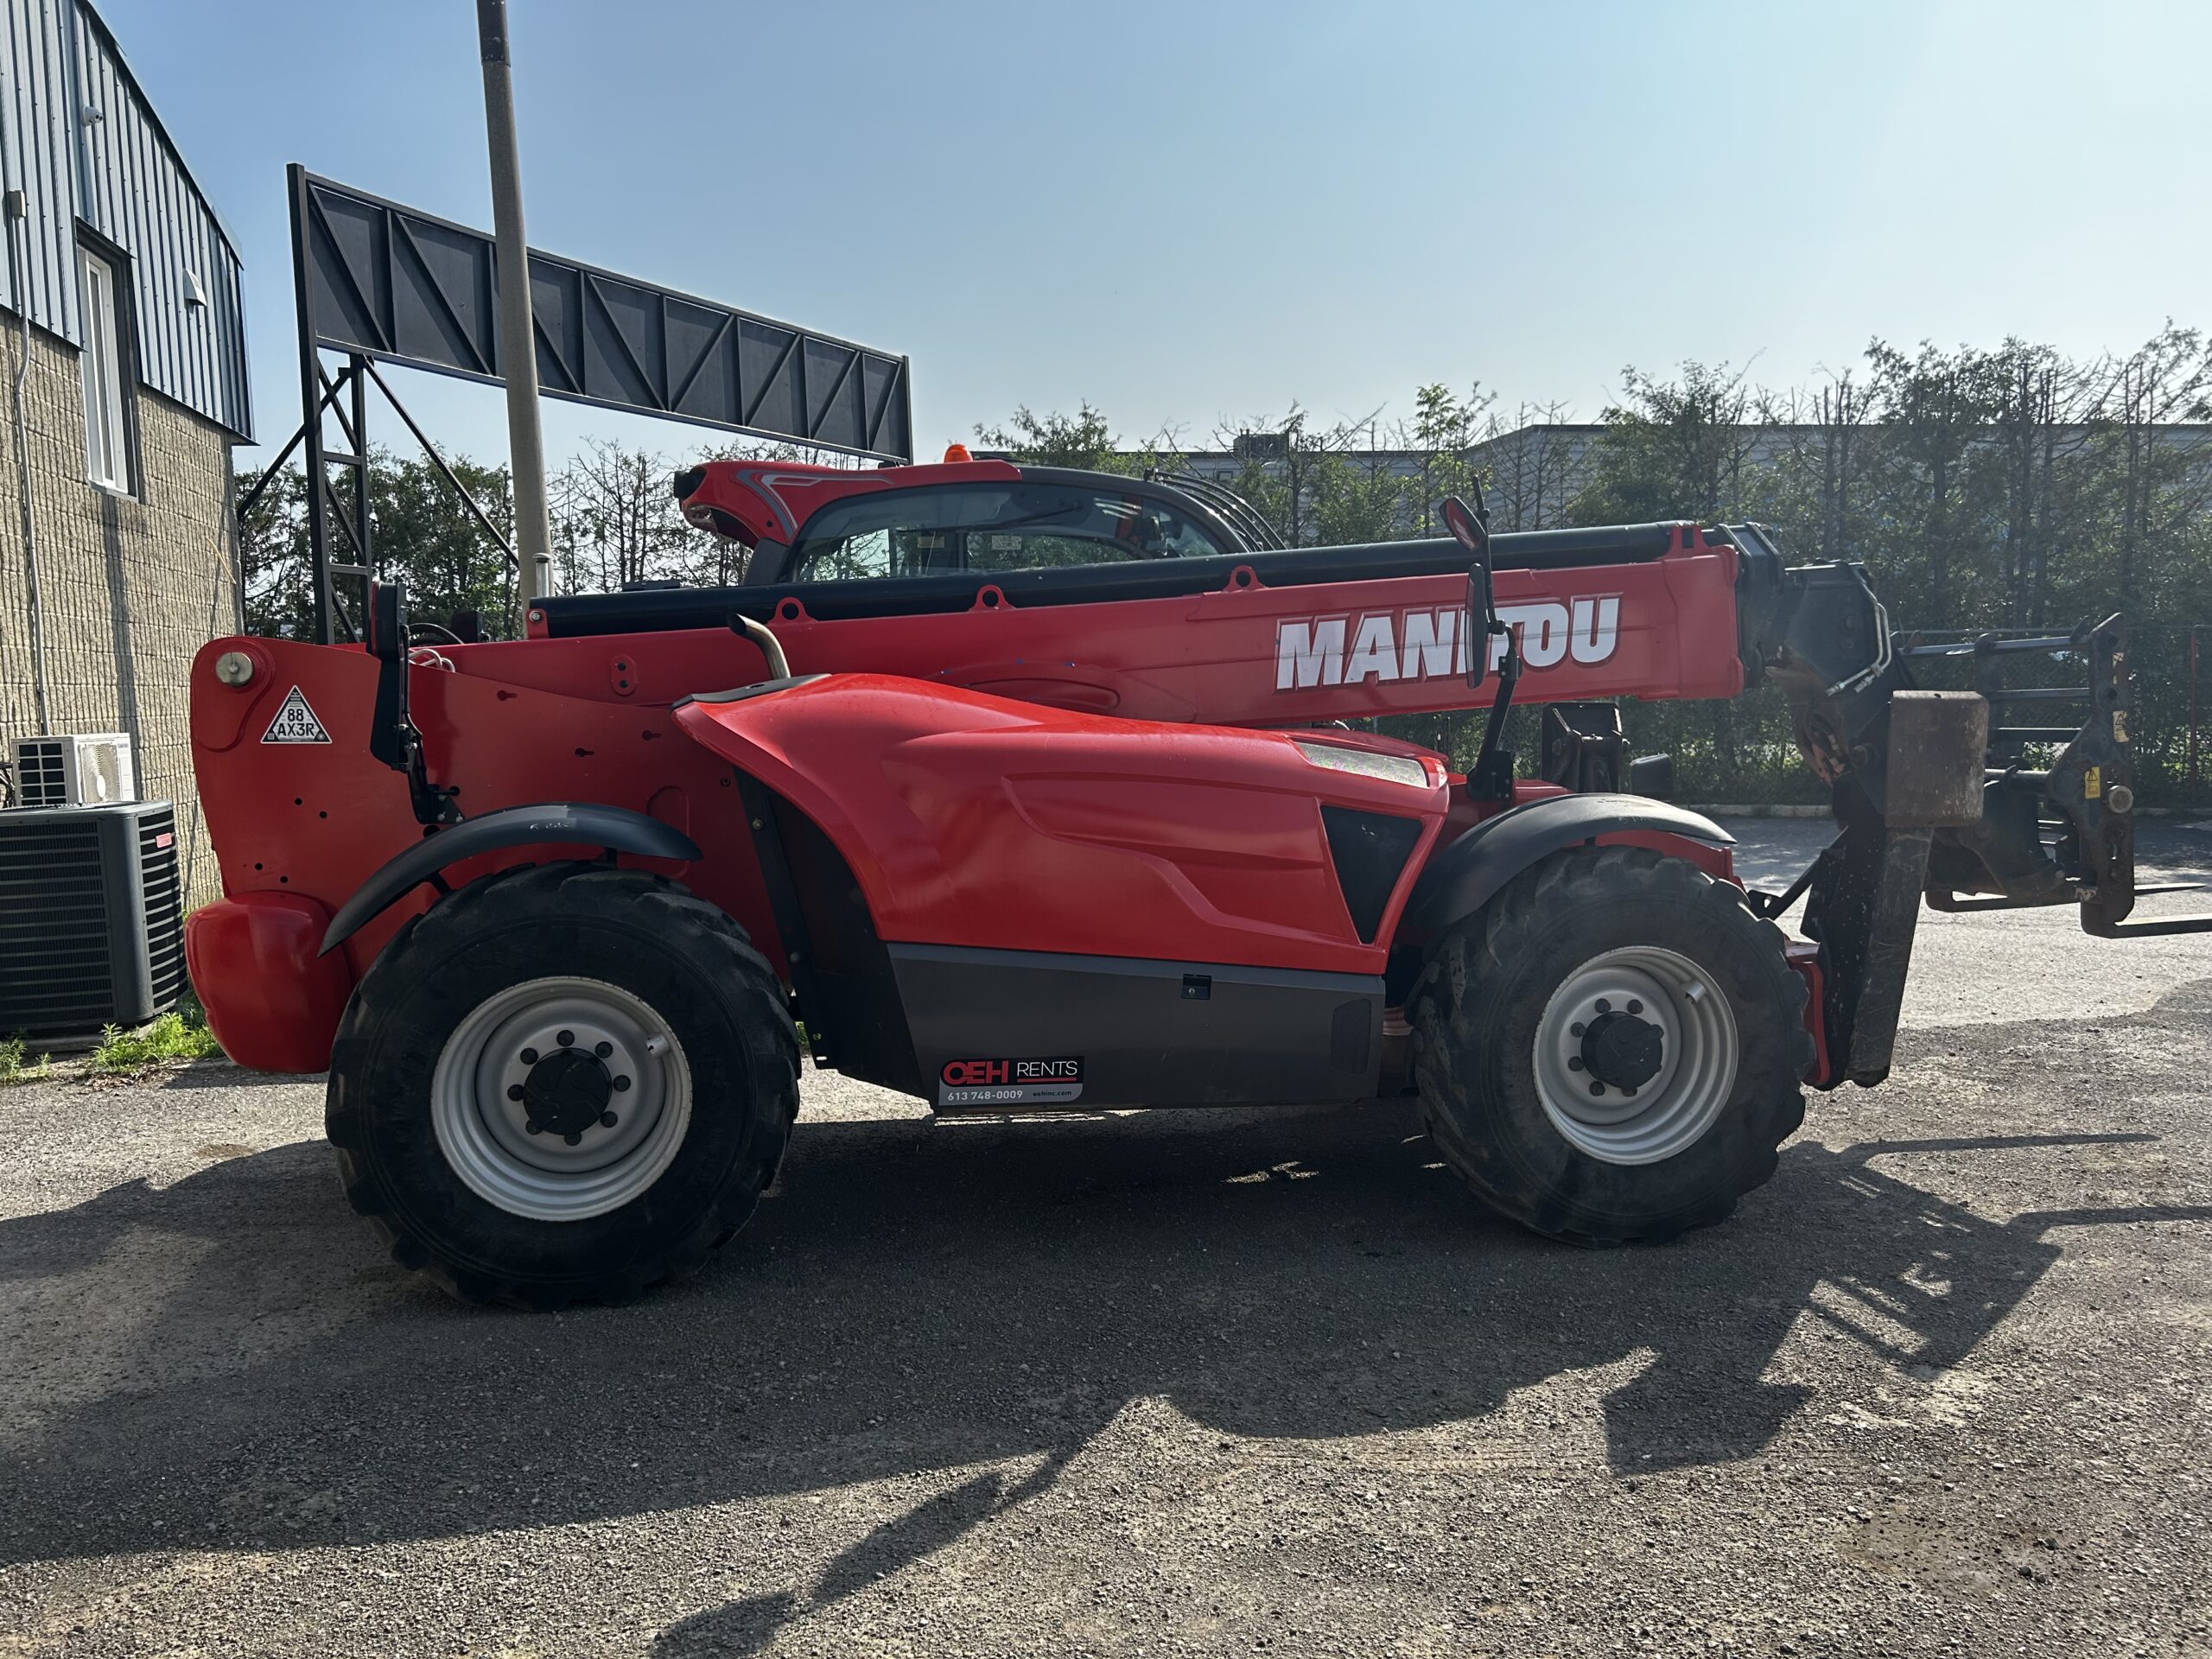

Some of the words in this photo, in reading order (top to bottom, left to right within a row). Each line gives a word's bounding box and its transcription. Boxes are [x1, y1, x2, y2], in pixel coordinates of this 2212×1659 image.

[287, 709, 304, 722] 88
[277, 723, 315, 736] AX3R
[944, 1060, 1009, 1085] OEH
[1016, 1061, 1078, 1077] RENTS
[947, 1091, 969, 1101] 613
[971, 1090, 1023, 1100] 748-0009
